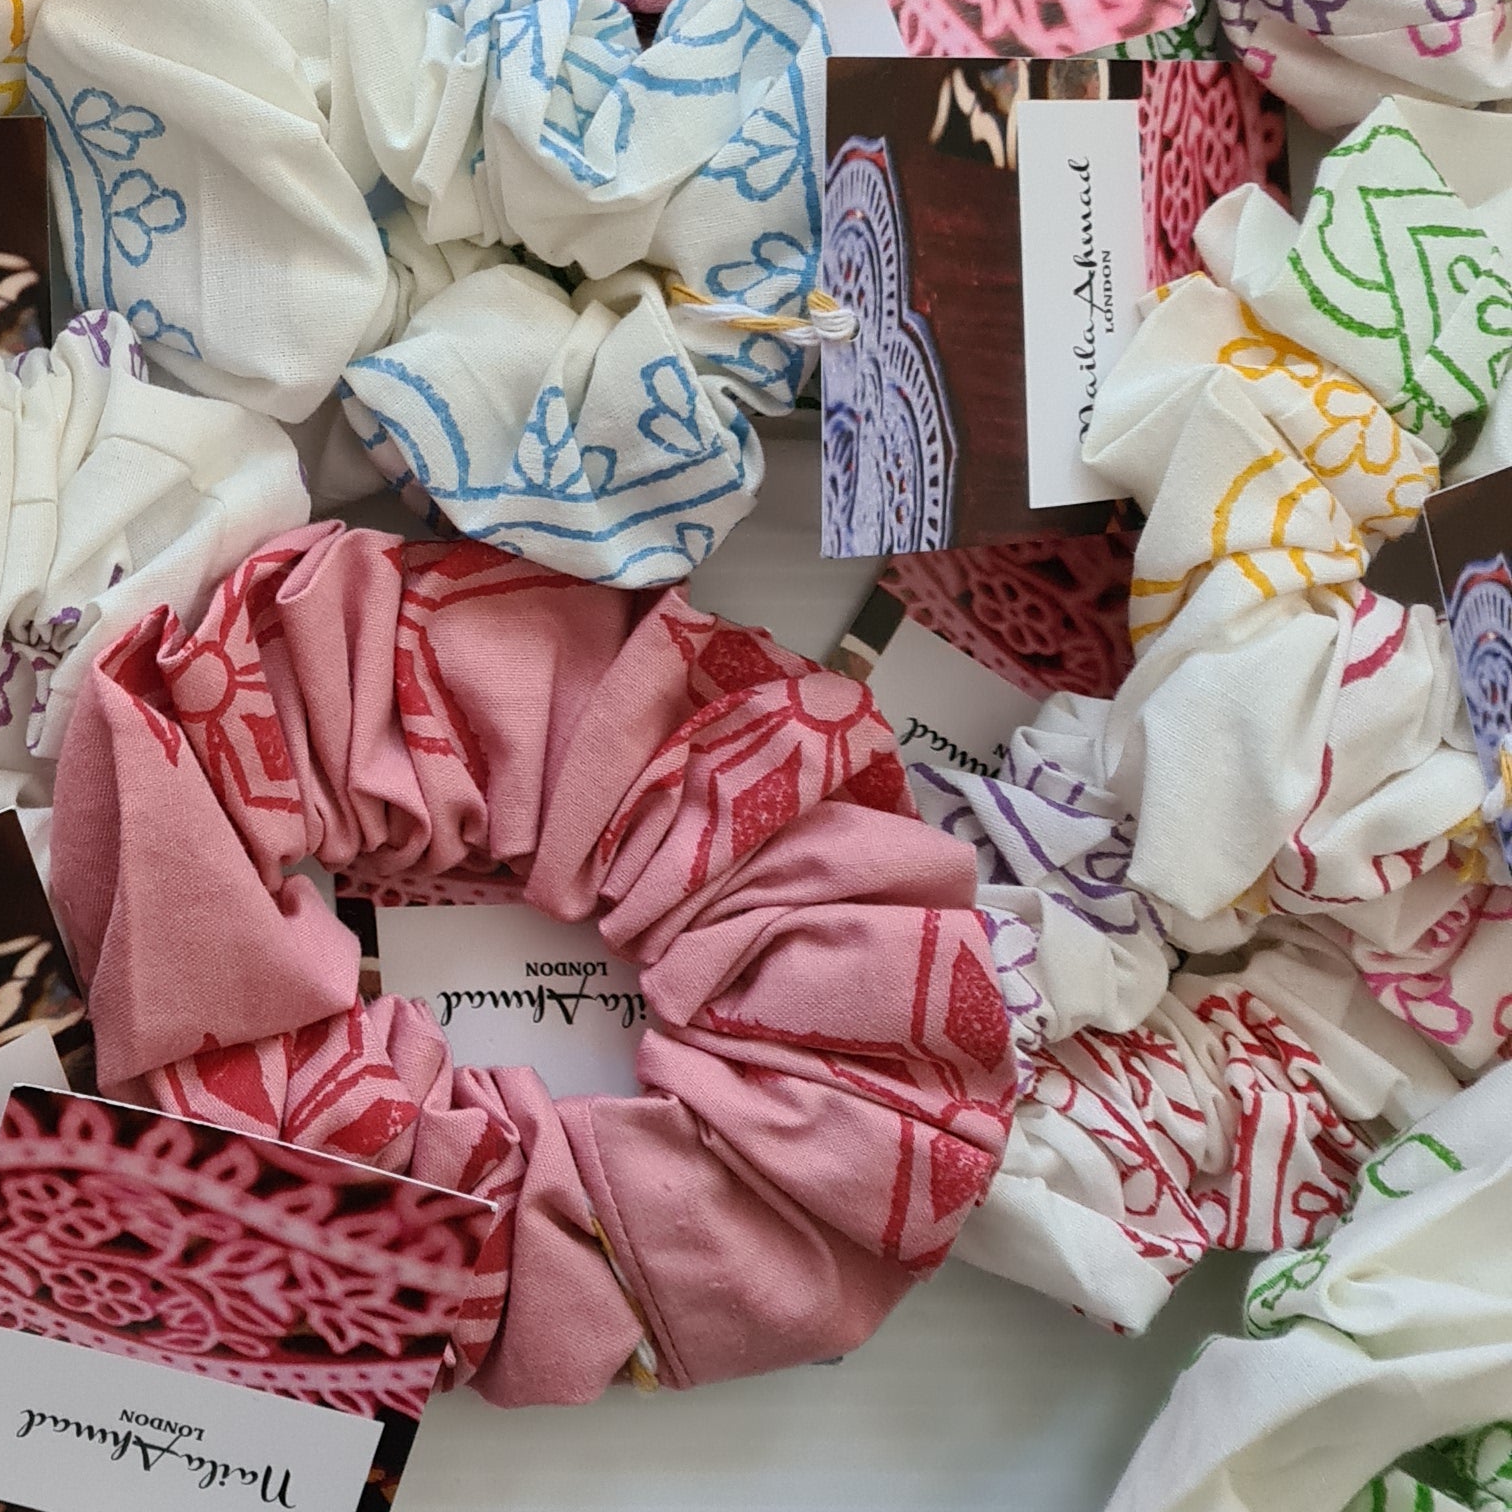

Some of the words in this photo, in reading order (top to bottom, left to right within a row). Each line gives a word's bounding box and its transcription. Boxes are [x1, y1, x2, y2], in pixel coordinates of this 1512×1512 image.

[1068, 155, 1106, 319] Ahmad
[1102, 249, 1116, 335] LONDON
[526, 961, 608, 978] LONDON
[437, 976, 594, 1027] Ahmad
[15, 1408, 181, 1472] Ahmad
[118, 1408, 206, 1442] LONDON
[176, 1451, 296, 1510] Naila
